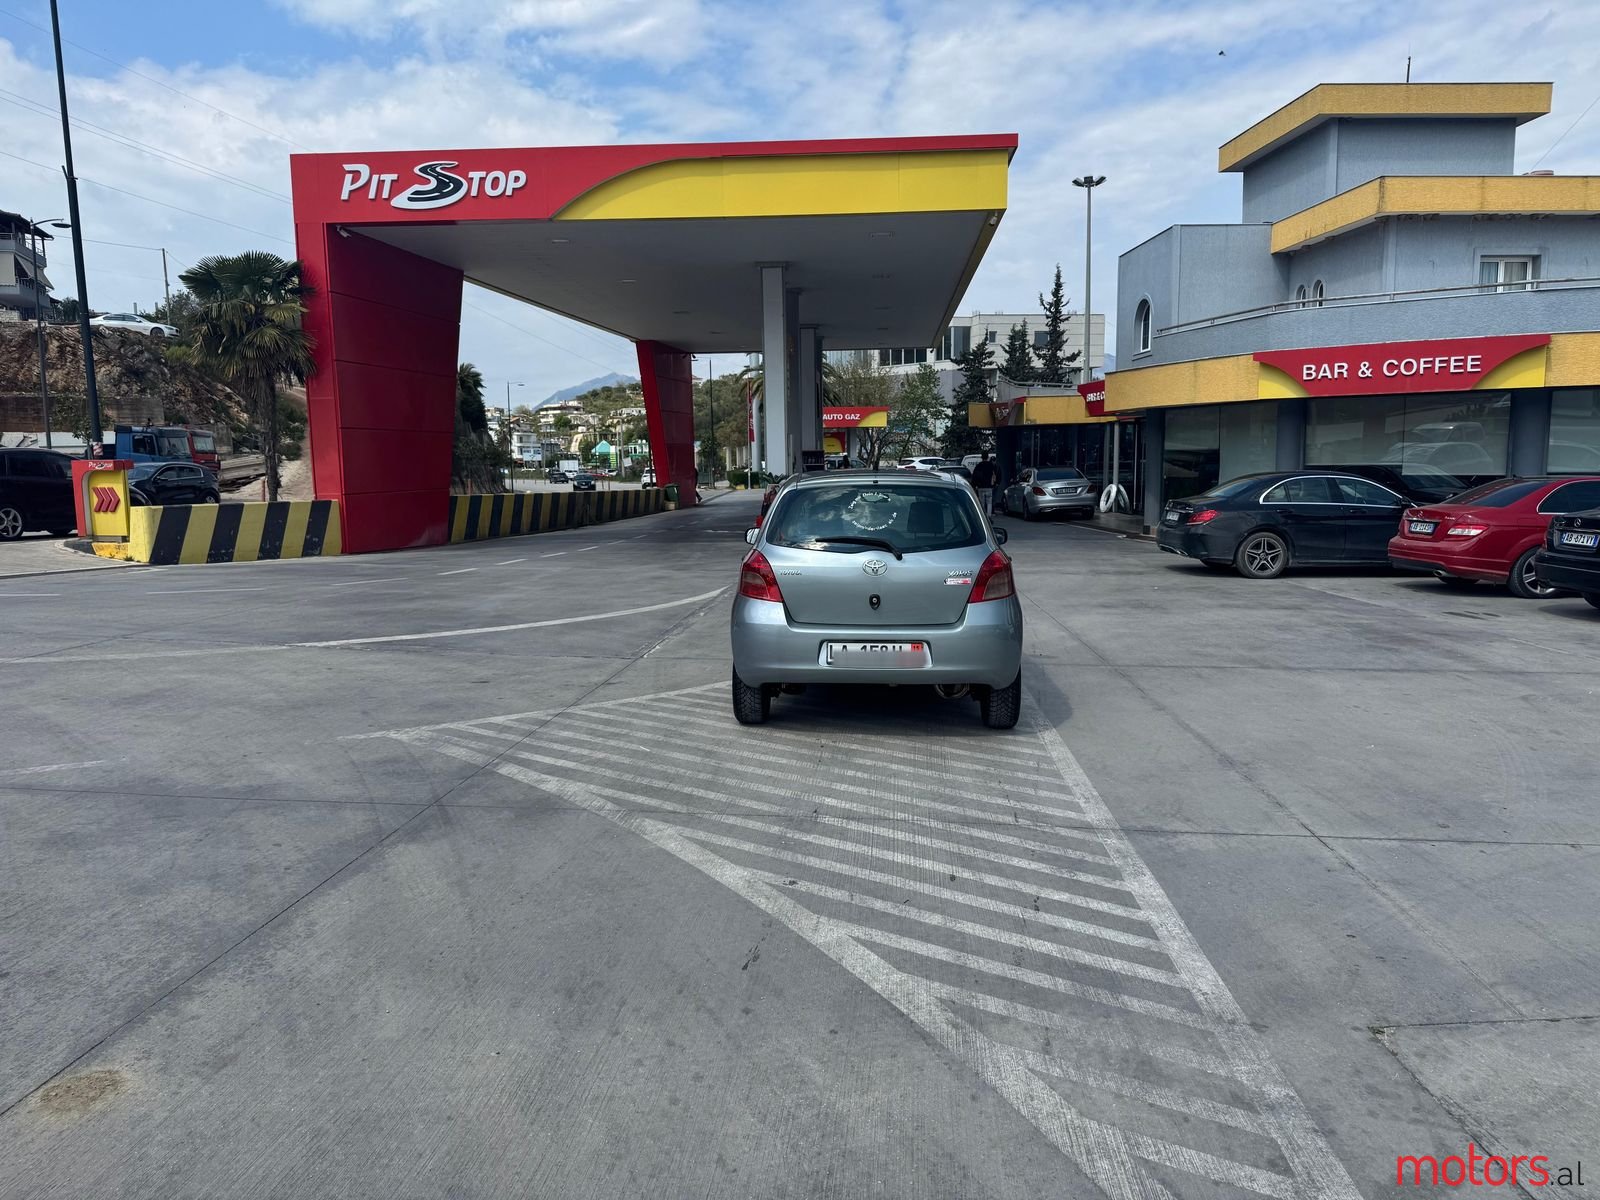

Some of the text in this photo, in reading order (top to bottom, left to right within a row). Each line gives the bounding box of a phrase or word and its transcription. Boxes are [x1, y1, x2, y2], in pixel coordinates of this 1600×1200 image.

[341, 160, 527, 210] PIT STOP
[1302, 354, 1482, 380] BAR & COFFEE
